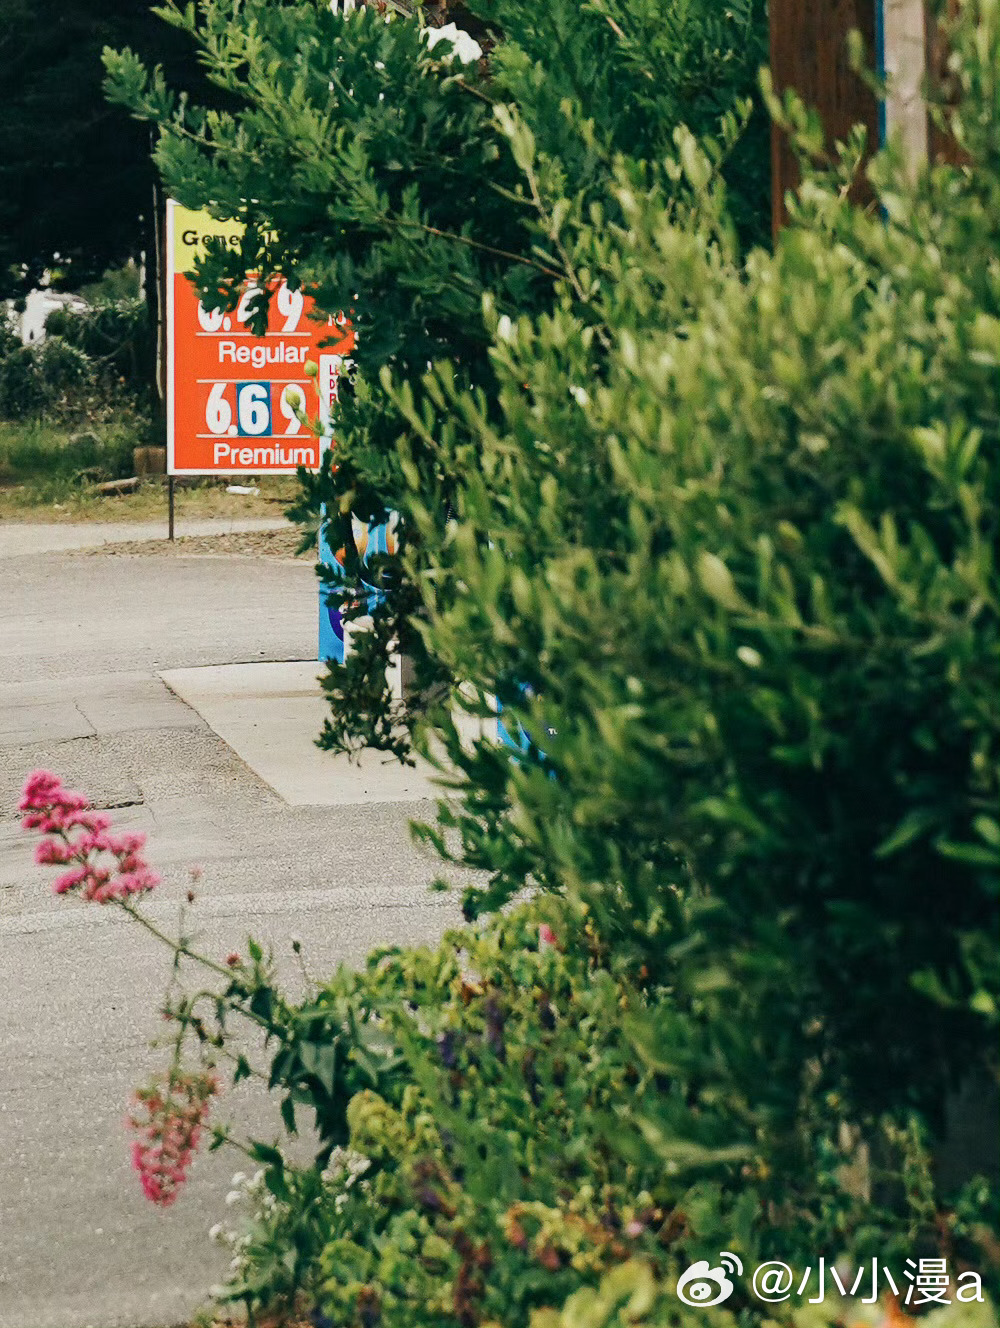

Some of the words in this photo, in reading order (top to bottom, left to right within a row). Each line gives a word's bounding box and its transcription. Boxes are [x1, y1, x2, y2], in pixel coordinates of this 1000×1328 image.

[218, 341, 309, 369] Regular
[205, 382, 307, 435] 6.69
[213, 443, 315, 465] Premium
